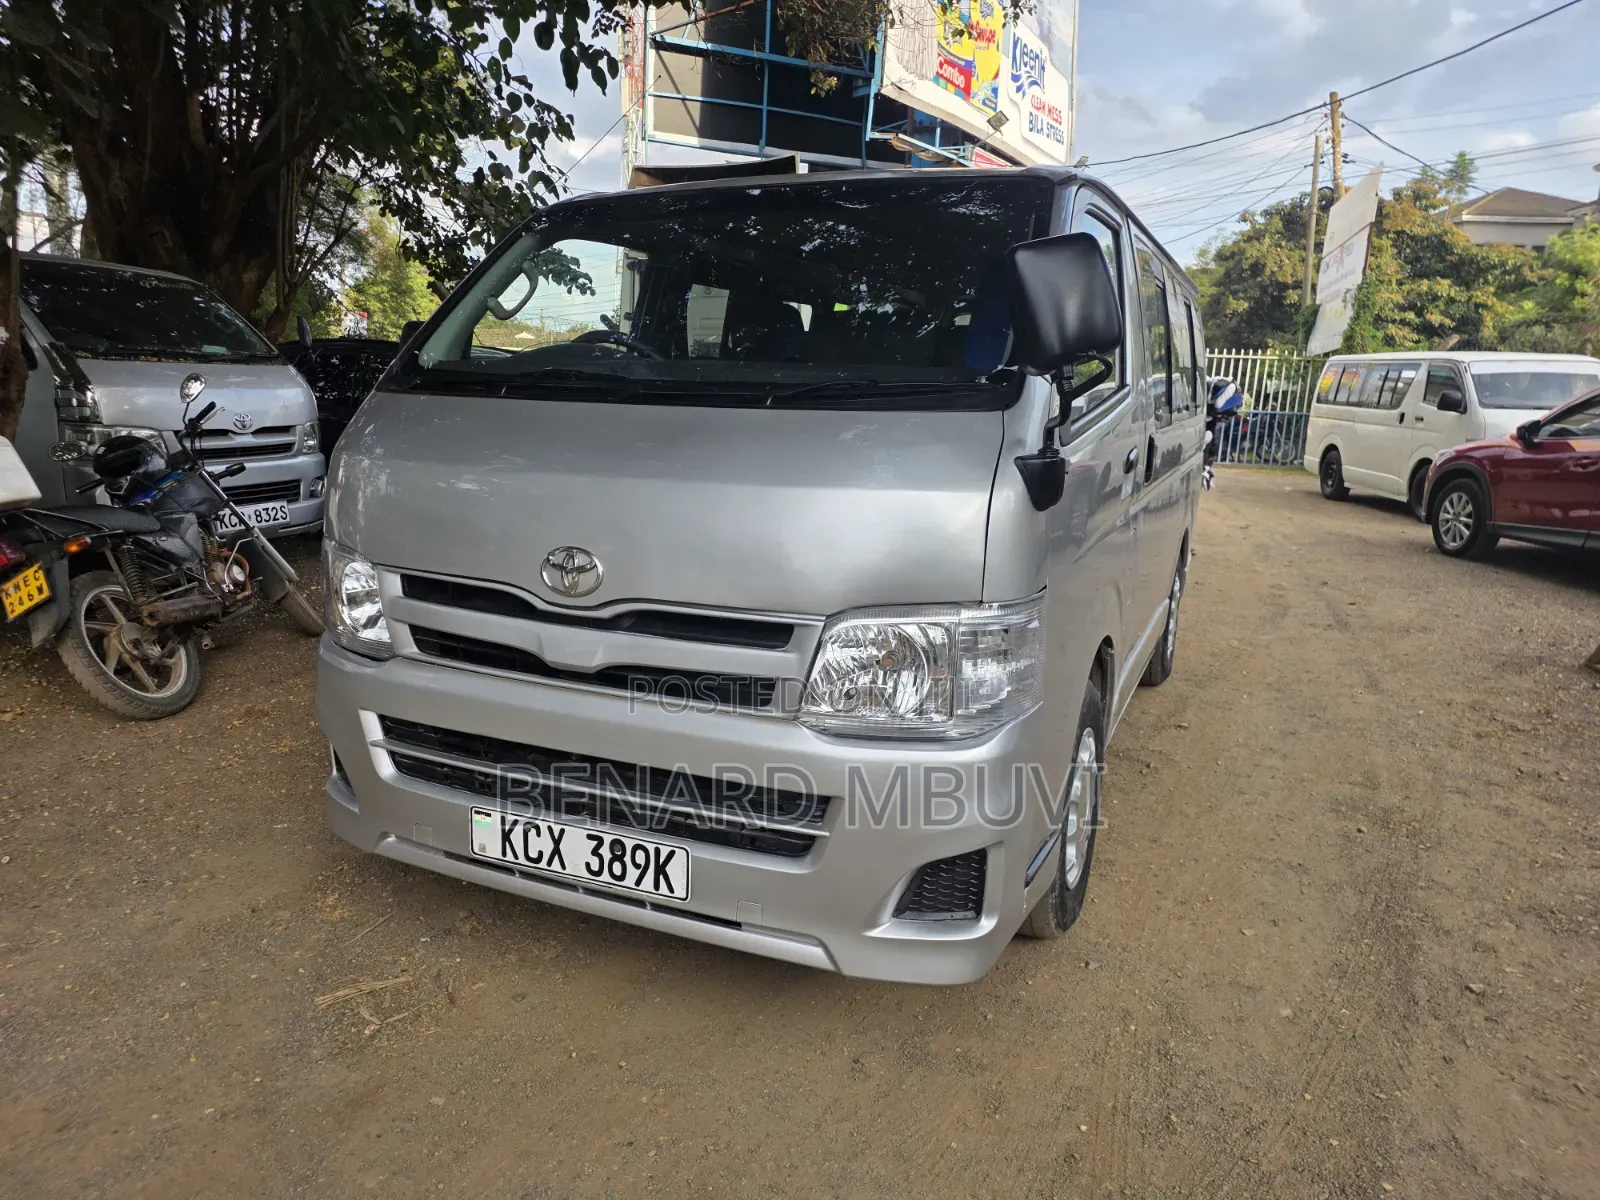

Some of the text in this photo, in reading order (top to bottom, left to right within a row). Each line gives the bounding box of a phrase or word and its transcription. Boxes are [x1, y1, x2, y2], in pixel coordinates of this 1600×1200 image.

[937, 55, 965, 89] Combo
[1011, 31, 1046, 90] Kleenit
[1030, 94, 1063, 126] CLEAN MESS
[1028, 111, 1064, 146] BILA STRESS
[254, 505, 288, 525] 832S
[500, 815, 567, 871] KCX
[584, 833, 677, 895] 389K
